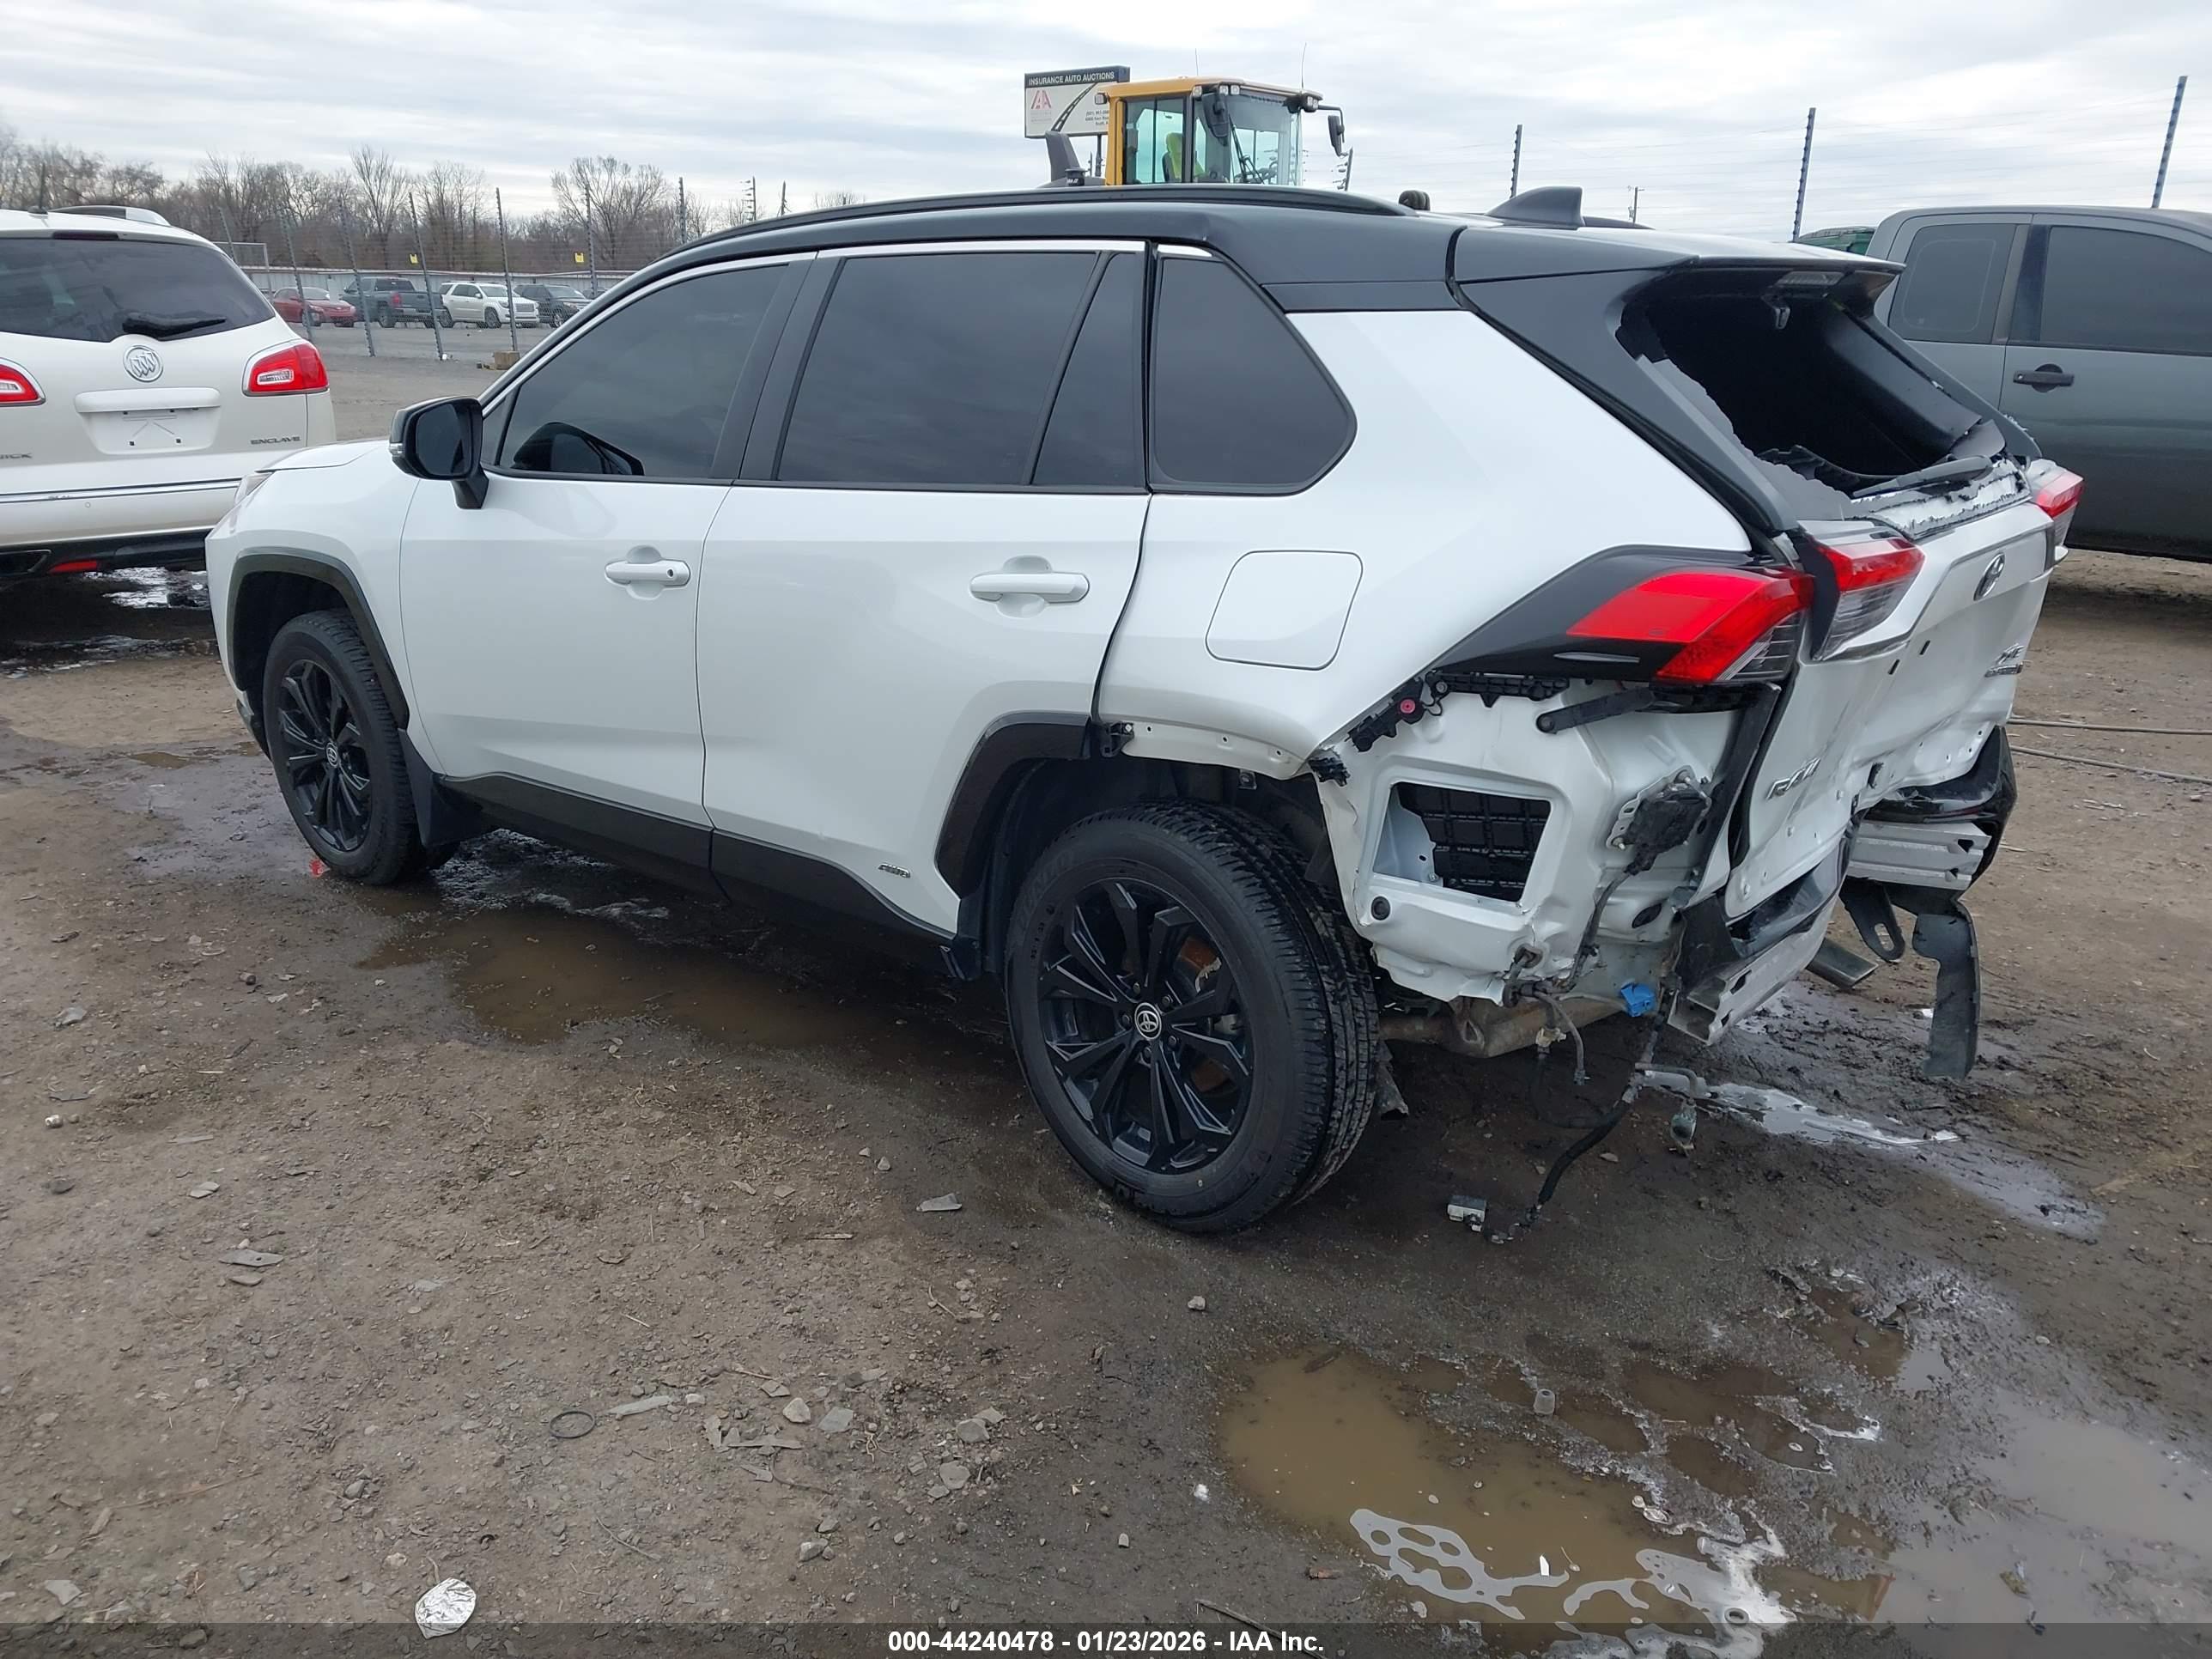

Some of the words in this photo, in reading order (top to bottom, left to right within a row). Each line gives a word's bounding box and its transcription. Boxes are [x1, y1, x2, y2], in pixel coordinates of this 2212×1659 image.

[1028, 76, 1064, 86] INSURANCE
[1082, 71, 1115, 82] AUCTIONS
[250, 436, 301, 445] ENCLAVE
